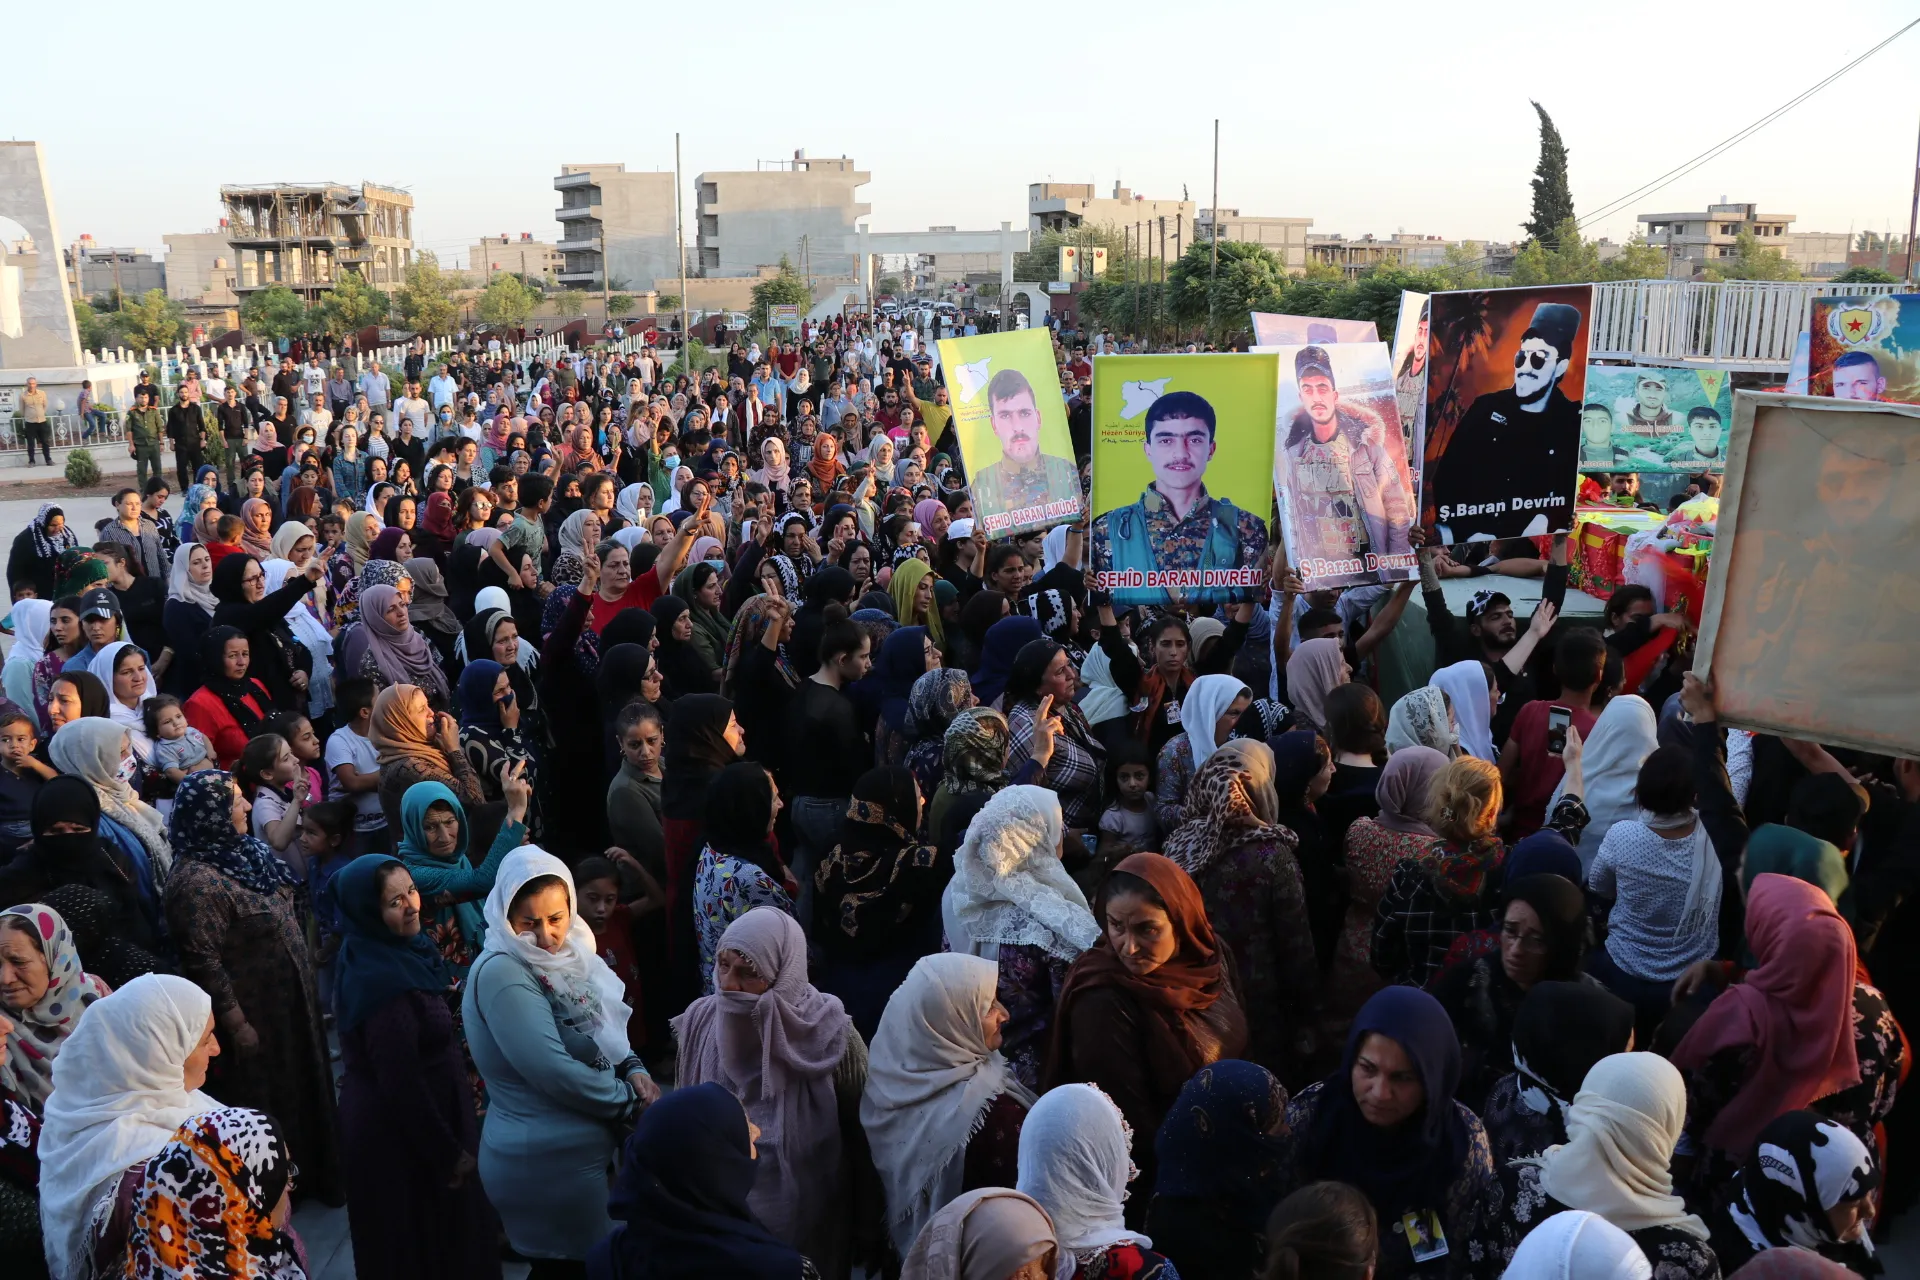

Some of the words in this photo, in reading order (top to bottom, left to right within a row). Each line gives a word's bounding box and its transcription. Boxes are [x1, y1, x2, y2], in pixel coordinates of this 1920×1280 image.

[1012, 505, 1046, 526] BARAN
[1097, 567, 1143, 591] ŞEHÎD
[1147, 569, 1201, 587] BARAN
[1204, 565, 1263, 586] DIVRÊM
